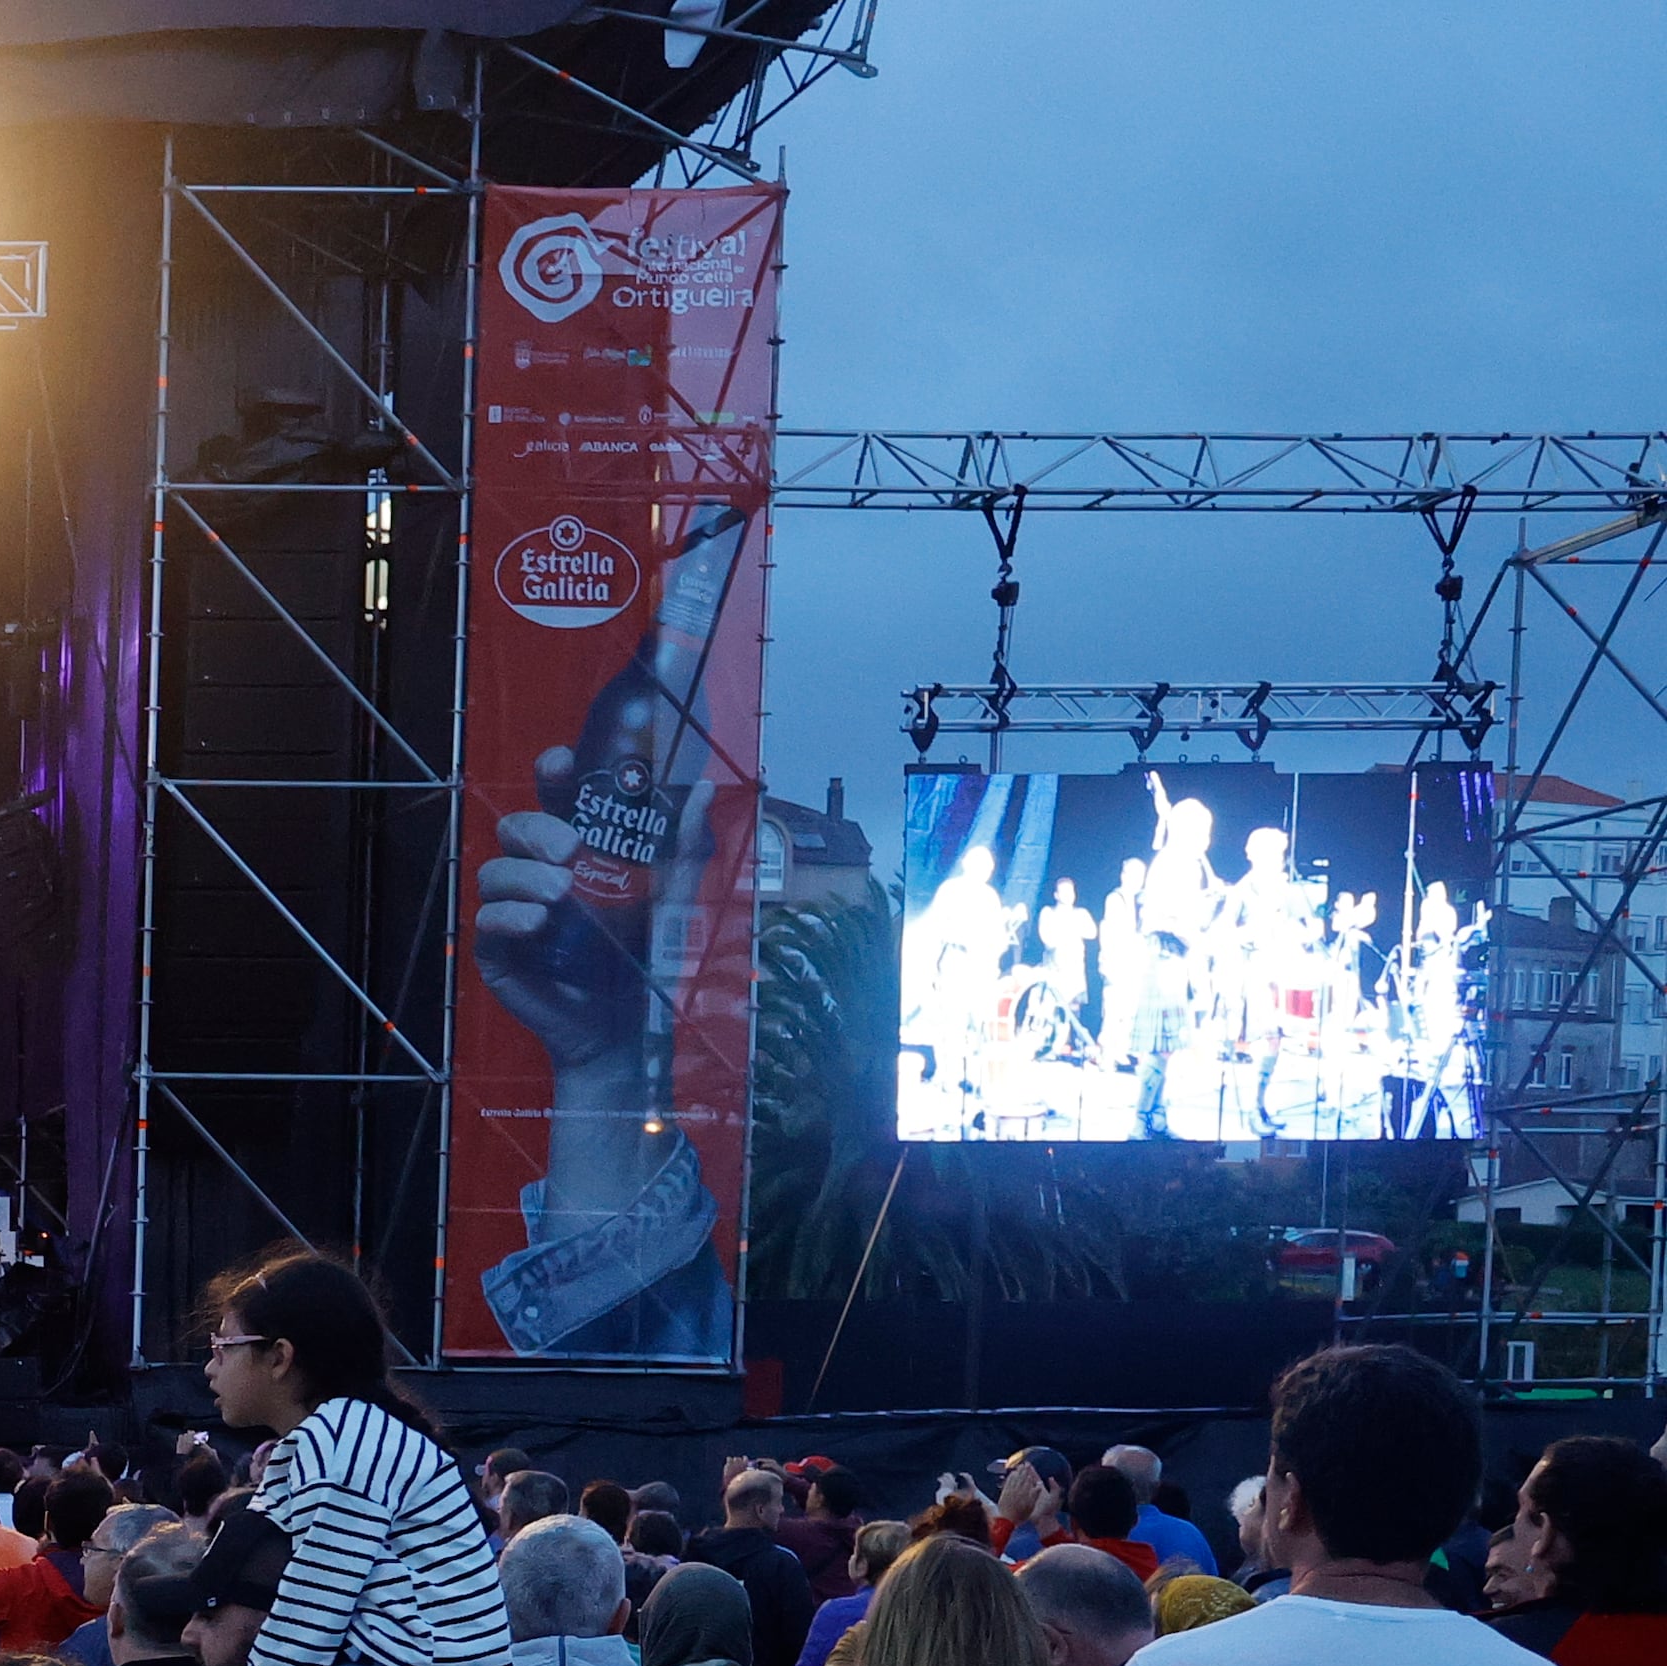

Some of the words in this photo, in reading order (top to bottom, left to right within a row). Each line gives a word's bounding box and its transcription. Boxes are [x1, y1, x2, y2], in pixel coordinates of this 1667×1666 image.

[627, 226, 746, 259] festival
[613, 285, 754, 314] Ortigueira
[520, 548, 614, 575] Estrella
[523, 574, 609, 601] Galicia
[574, 783, 668, 836] Estrella
